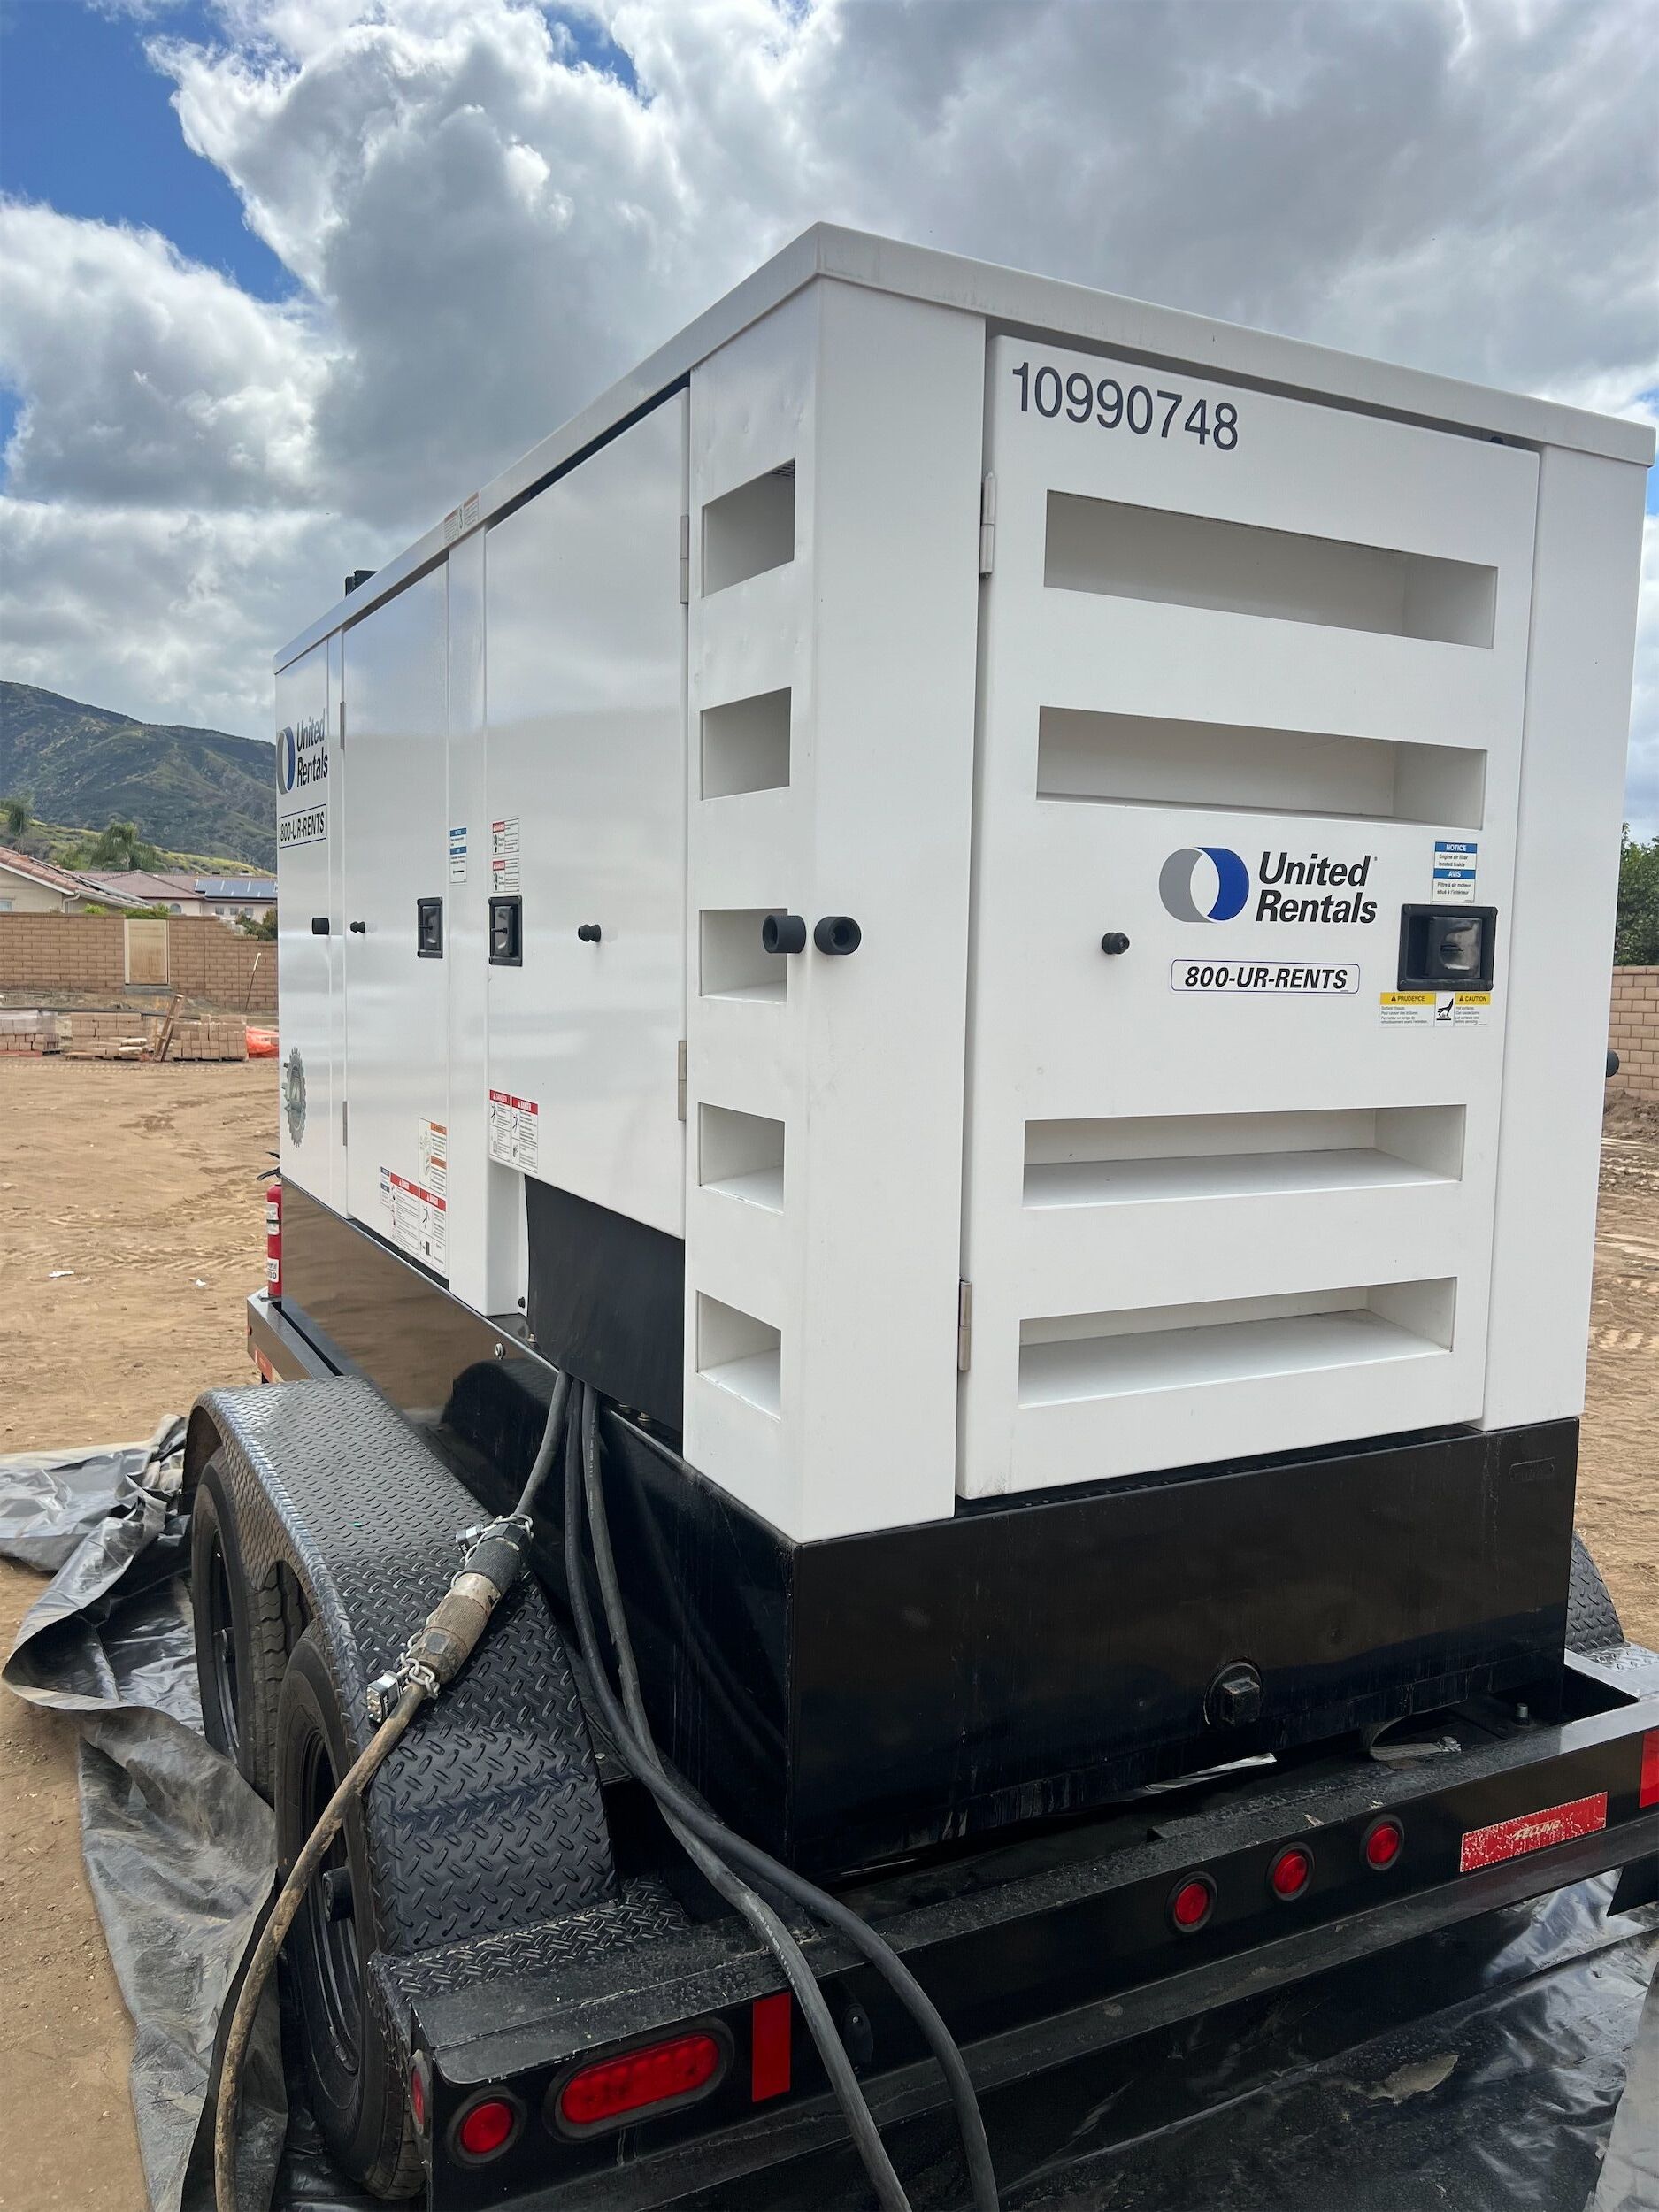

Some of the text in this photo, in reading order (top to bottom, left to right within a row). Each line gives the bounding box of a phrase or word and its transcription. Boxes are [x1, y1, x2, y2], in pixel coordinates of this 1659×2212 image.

[1012, 361, 1239, 450] 10990748
[296, 709, 326, 751] United
[296, 748, 328, 787] Rentals
[280, 812, 325, 841] 800-UR-RENTS
[1259, 851, 1371, 887] United
[1256, 889, 1378, 924] Rentals
[1184, 966, 1348, 990] 800-UR-RENTS
